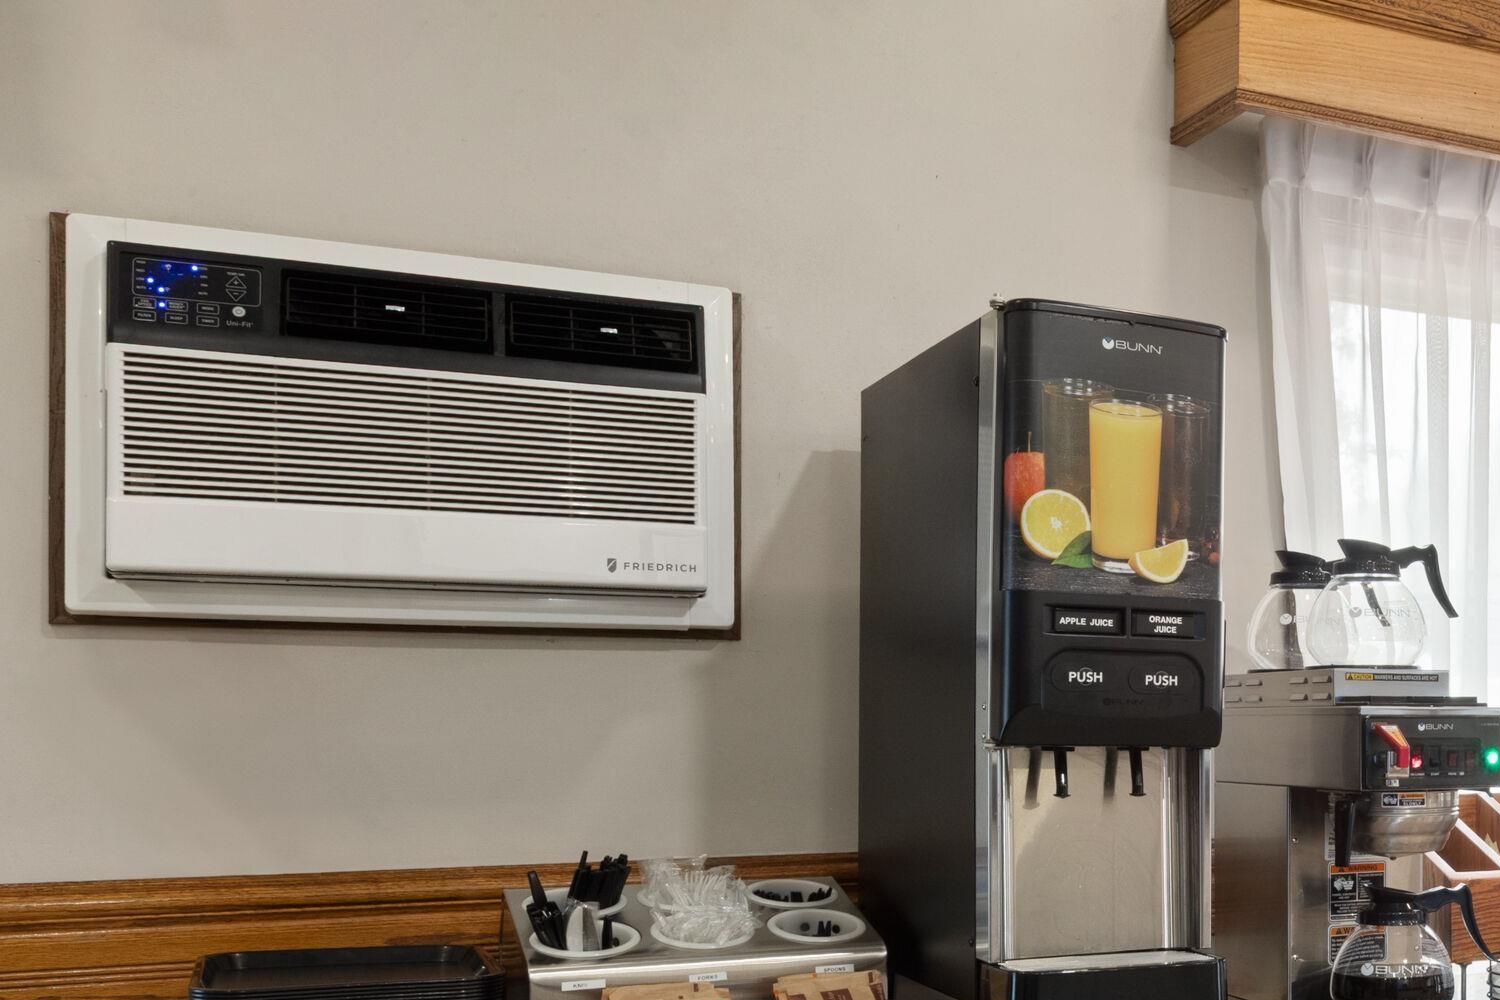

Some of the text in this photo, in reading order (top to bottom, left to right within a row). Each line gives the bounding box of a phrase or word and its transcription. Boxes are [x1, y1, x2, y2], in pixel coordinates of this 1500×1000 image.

[1115, 340, 1162, 354] BUNN
[623, 562, 696, 572] FRIEDRICH
[1059, 617, 1114, 627] APPLE JUICE
[1149, 616, 1183, 625] ORANGE
[1153, 626, 1177, 634] JUICE
[1068, 672, 1103, 683] PUSH
[1145, 675, 1178, 686] PUSH
[1375, 965, 1429, 975] BUNN
